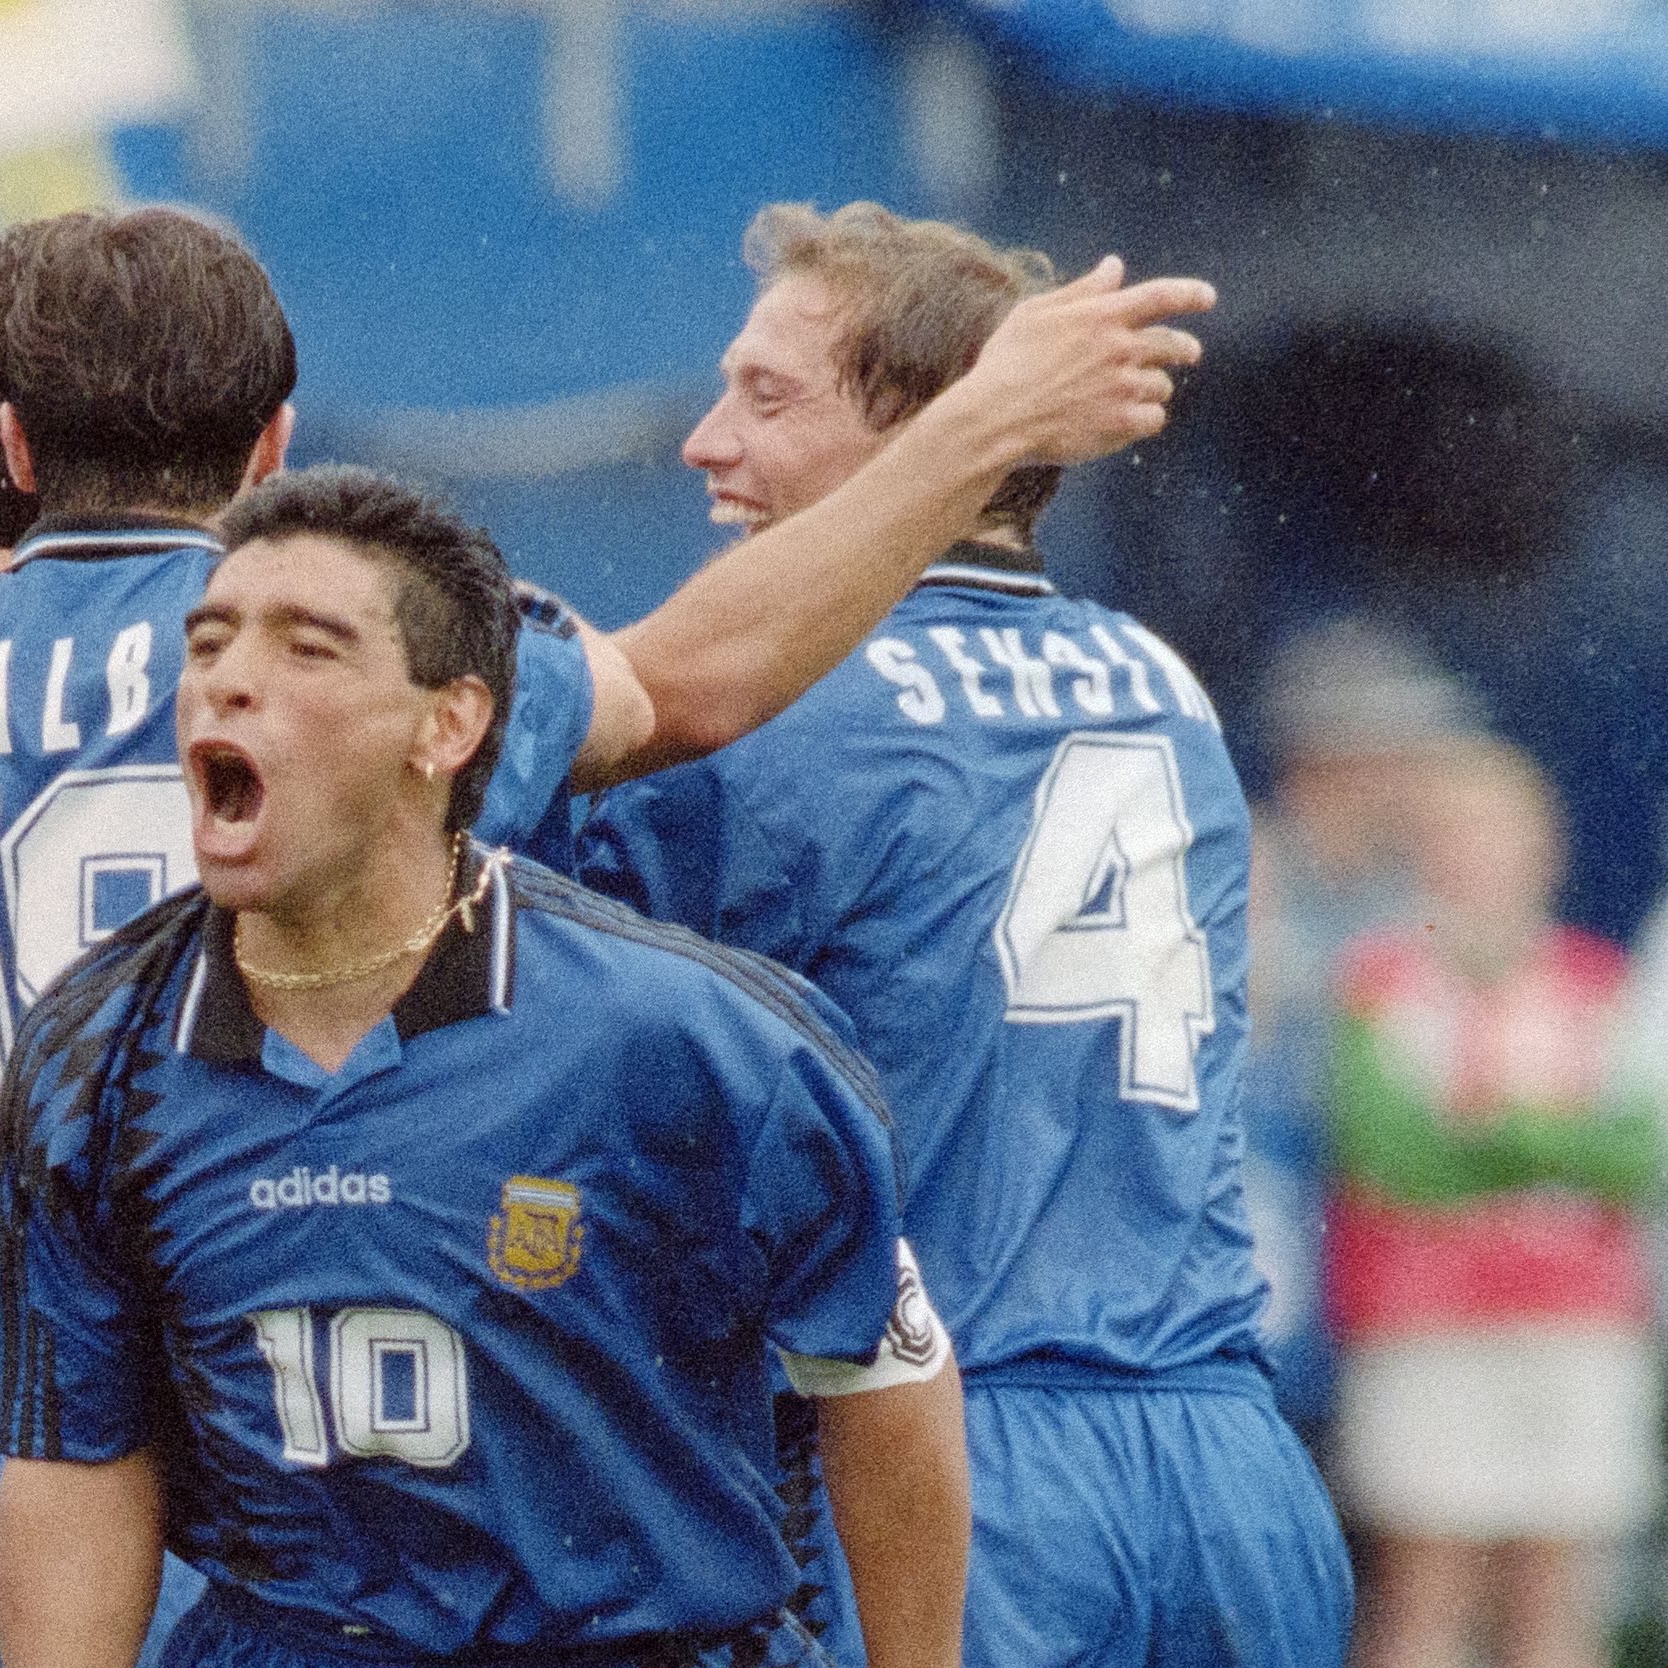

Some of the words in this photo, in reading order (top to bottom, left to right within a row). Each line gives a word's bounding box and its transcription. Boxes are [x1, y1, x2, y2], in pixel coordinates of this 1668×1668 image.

[994, 733, 1216, 1112] 4
[250, 1165, 391, 1208] adidas
[243, 1305, 469, 1466] 10
